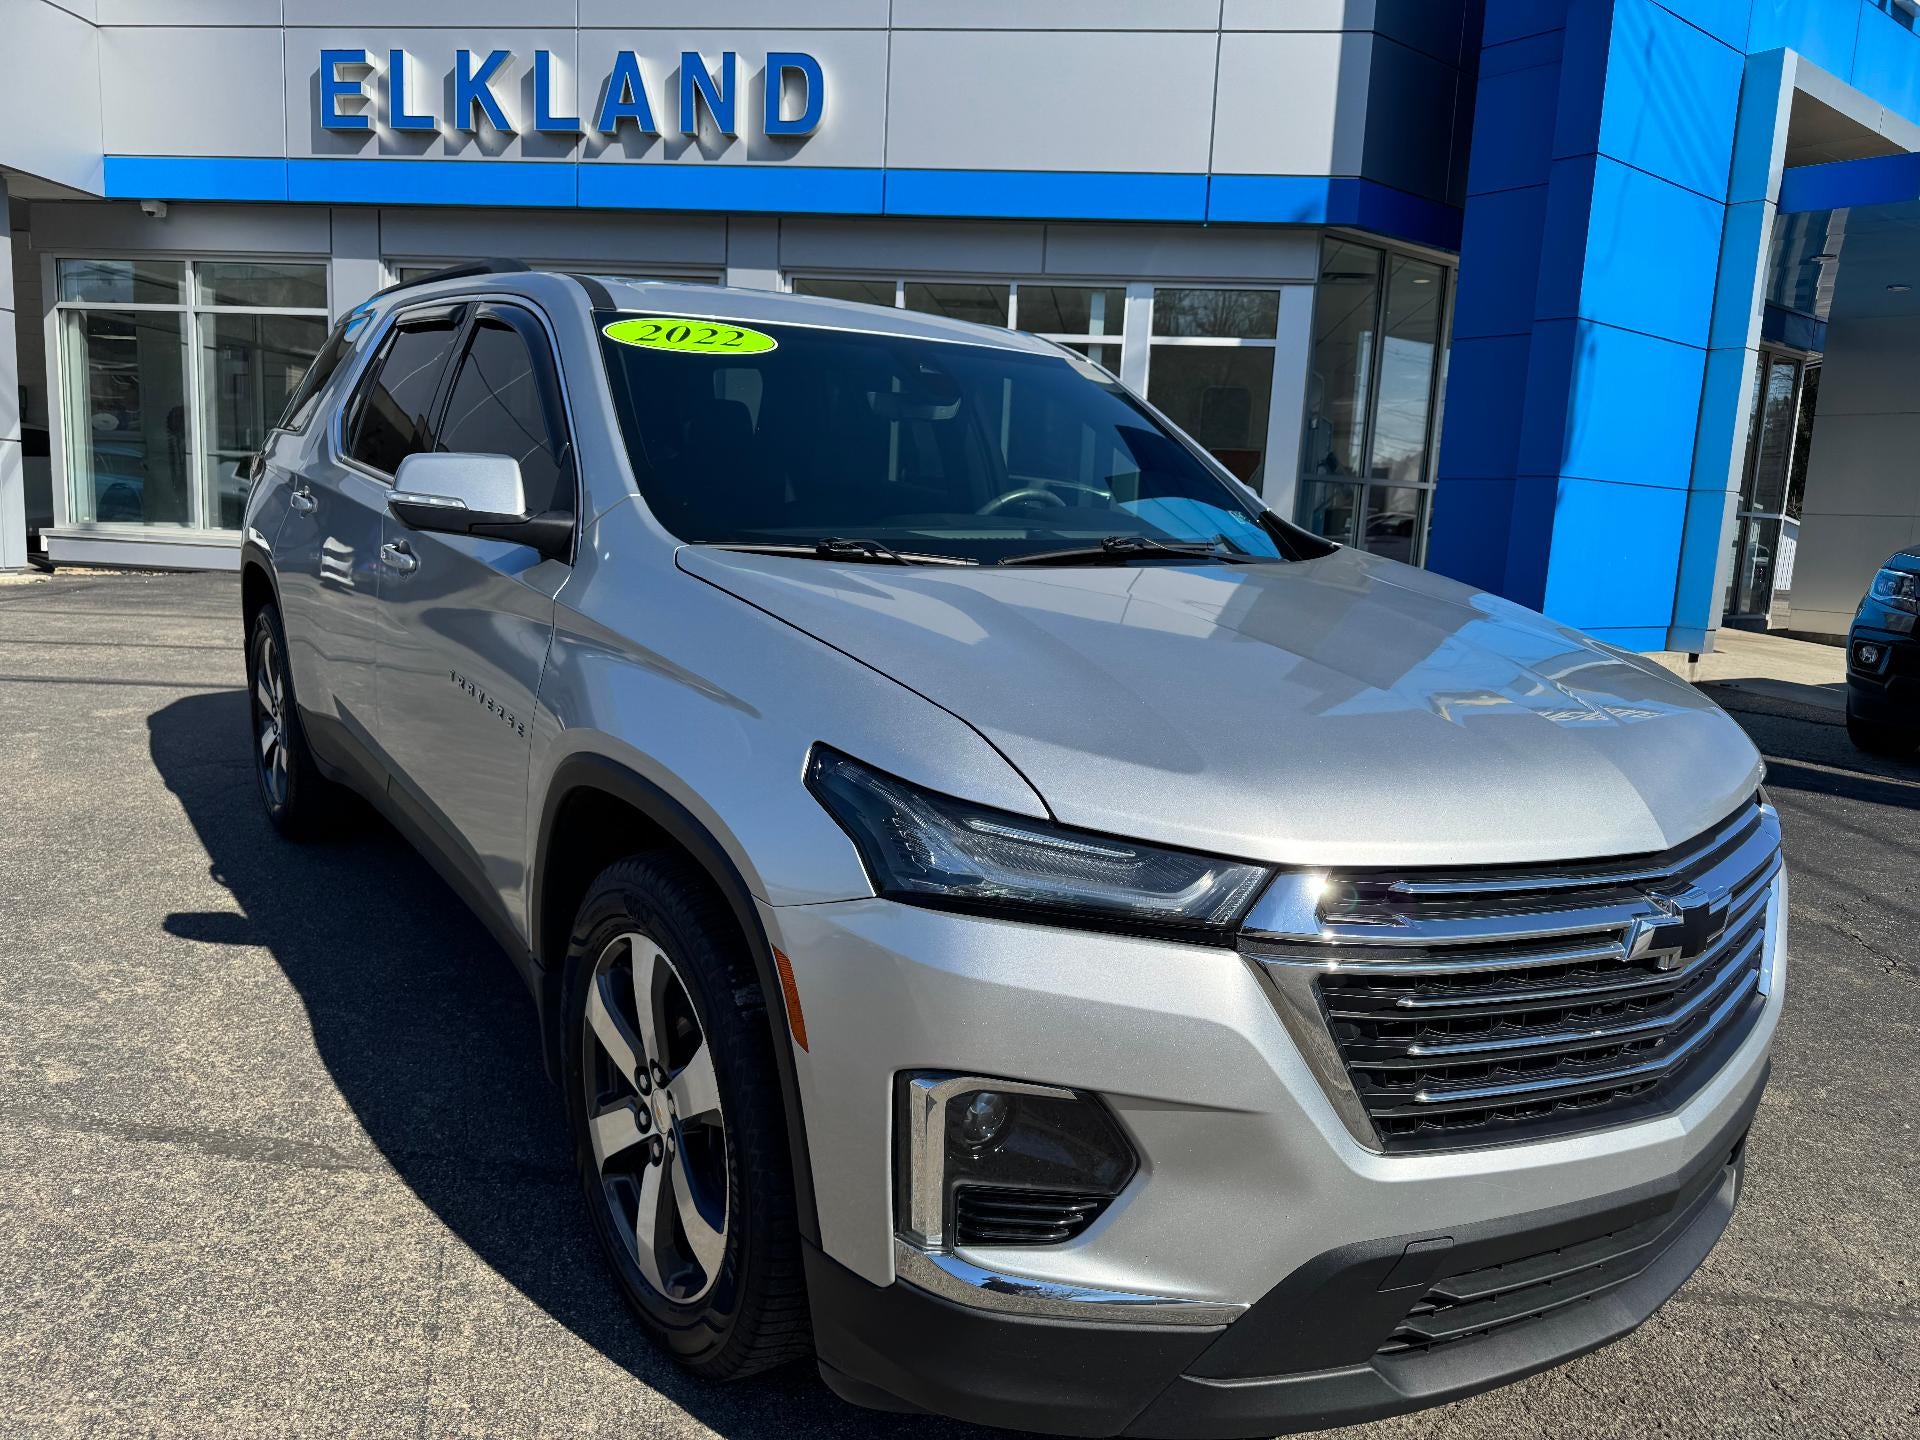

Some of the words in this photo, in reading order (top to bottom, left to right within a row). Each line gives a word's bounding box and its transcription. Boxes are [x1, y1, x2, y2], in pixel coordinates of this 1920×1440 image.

[319, 48, 825, 136] ELKLAND
[634, 323, 746, 348] 2022
[449, 668, 525, 738] TRAVERSE
